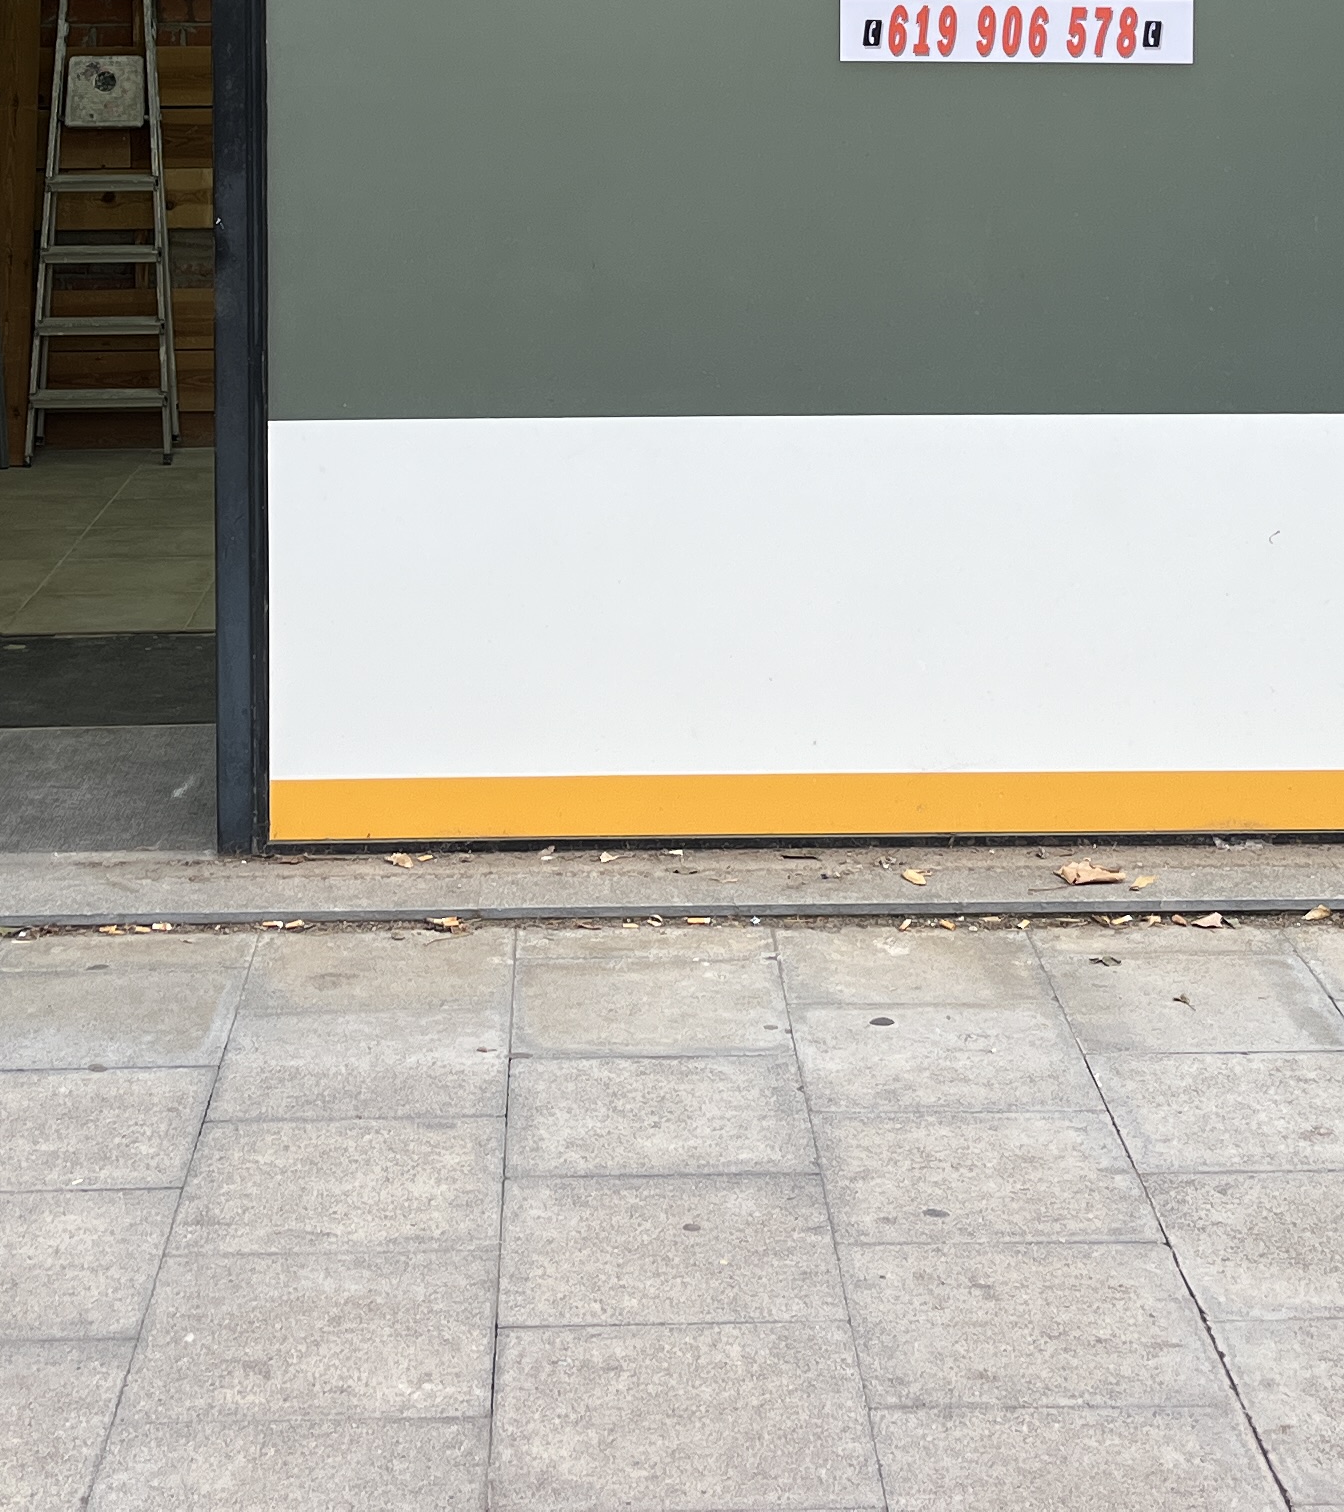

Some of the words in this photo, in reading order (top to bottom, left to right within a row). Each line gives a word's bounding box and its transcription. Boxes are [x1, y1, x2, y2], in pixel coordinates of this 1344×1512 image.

[888, 5, 957, 58] 619
[976, 5, 1049, 58] 906
[1066, 6, 1138, 59] 578
